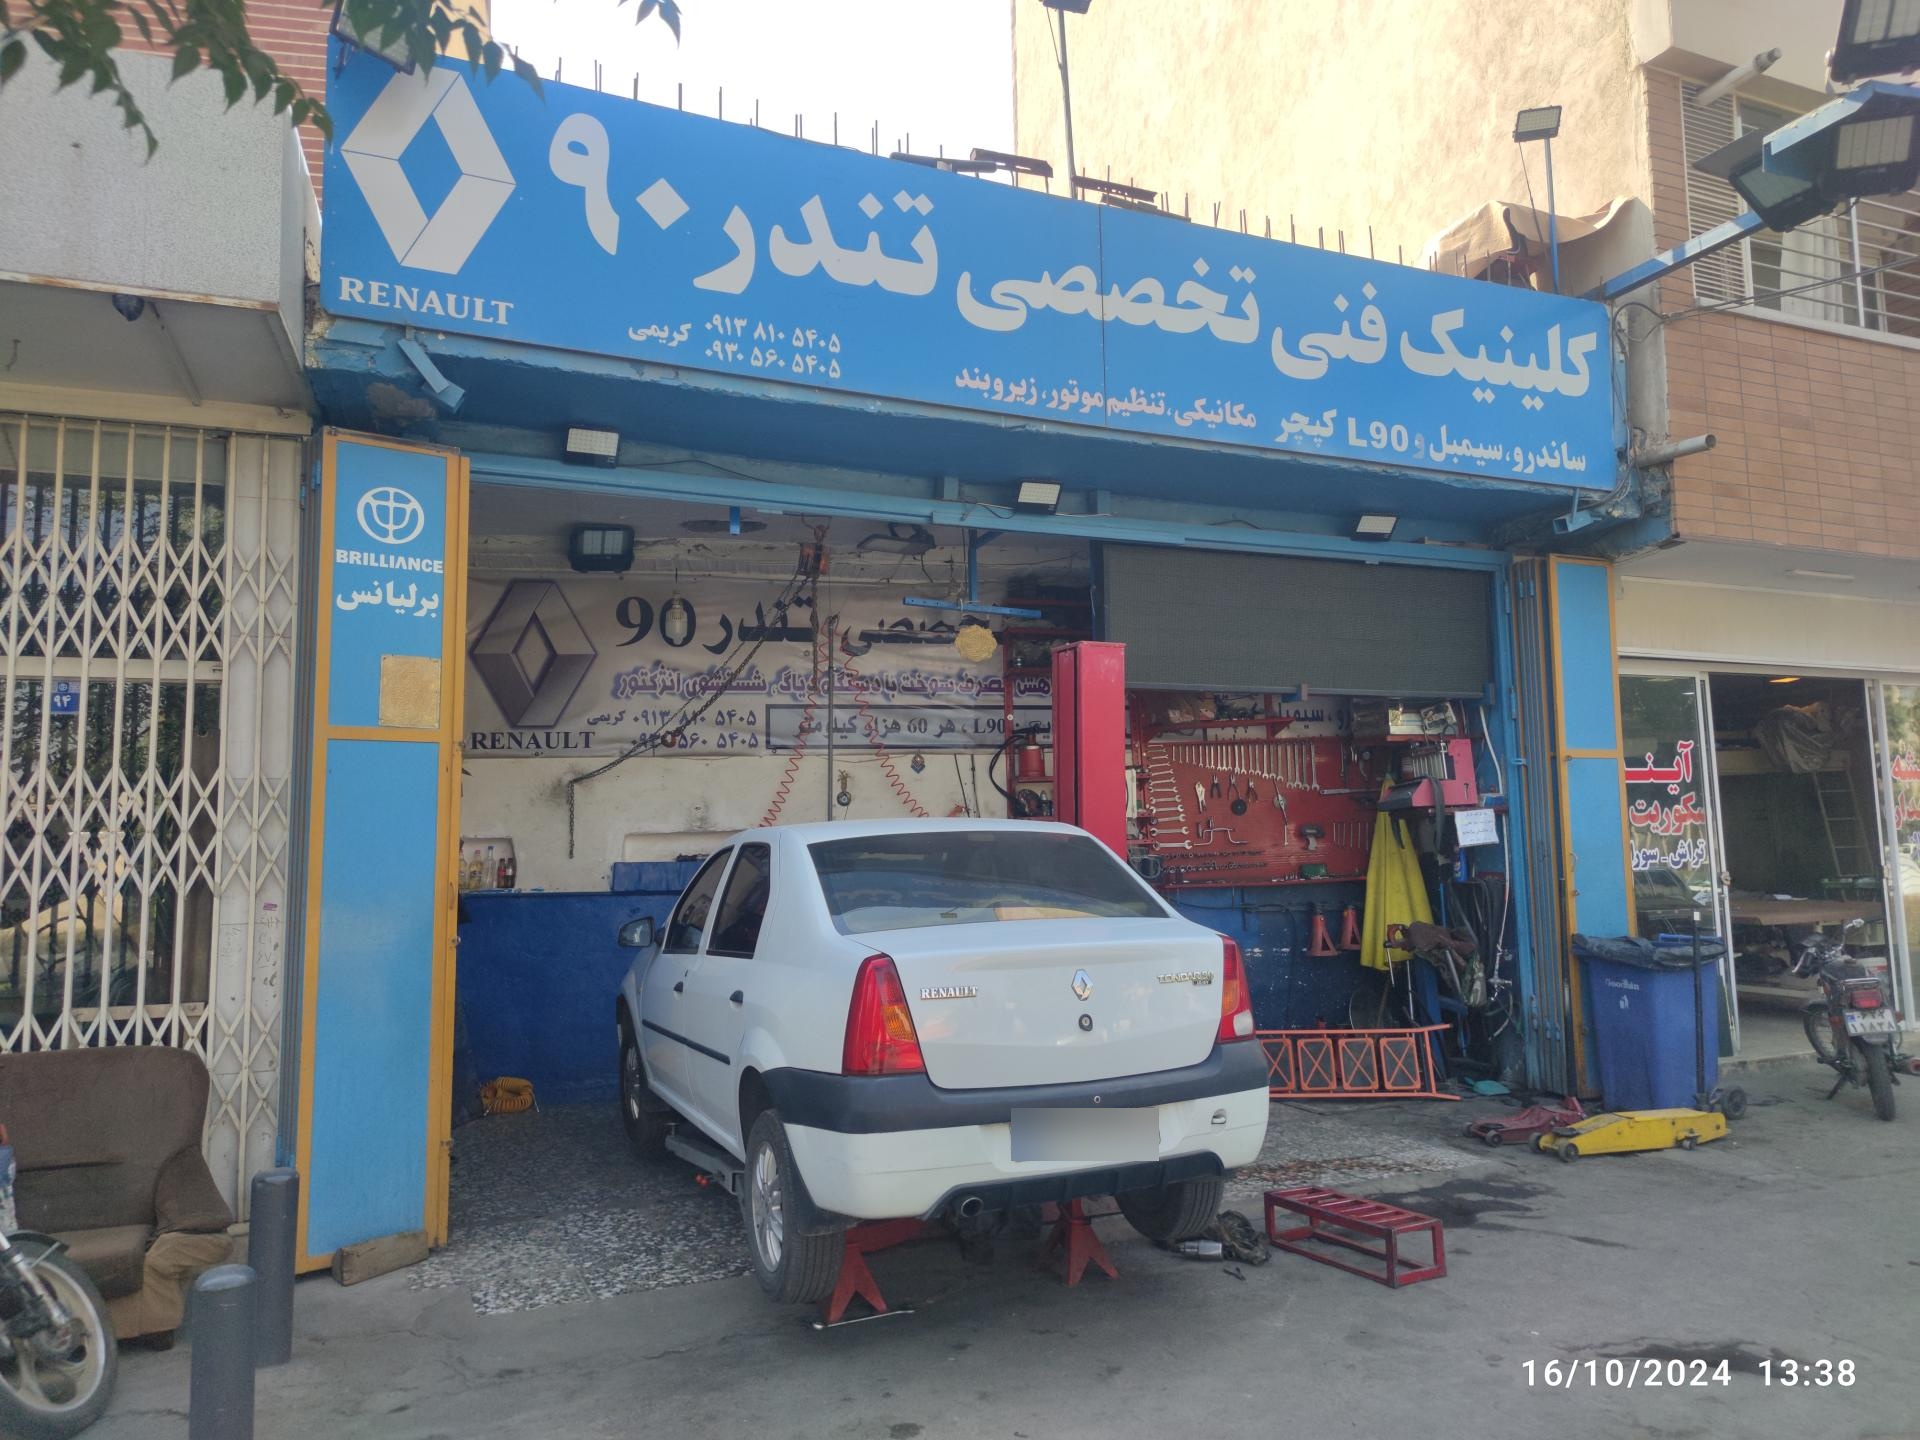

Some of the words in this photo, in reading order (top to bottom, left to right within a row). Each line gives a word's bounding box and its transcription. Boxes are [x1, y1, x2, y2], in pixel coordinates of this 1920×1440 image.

[549, 112, 690, 256] ۹۰
[693, 189, 939, 296] تندر
[339, 276, 515, 326] RENAULT
[957, 257, 1260, 345] تخصصی
[628, 322, 693, 347] کریمی
[704, 313, 748, 338] ۰۹۱۳
[752, 321, 786, 344] ۸۱۰
[791, 327, 842, 354] ۵۴۰۵
[1271, 281, 1388, 379] فنی
[704, 339, 745, 363] ۰۹۳۰
[750, 346, 787, 368] ۵۶۰
[791, 353, 842, 379] ۵۴۰۵
[1401, 308, 1597, 410] کلینیک
[1106, 386, 1166, 417] تنظیم
[1347, 416, 1409, 454] L90
[335, 548, 444, 574] BRILLIANCE
[335, 580, 440, 618] برلیانس
[615, 596, 697, 648] 90
[617, 663, 683, 699] انژکتور
[899, 673, 956, 698] سوخت
[586, 709, 626, 727] کریمی
[906, 717, 929, 735] 60
[973, 717, 1005, 735] L90
[471, 731, 596, 751] RENAULT
[1625, 739, 1695, 795] آین
[1669, 838, 1707, 869] تراش
[920, 986, 978, 1000] RENAULT
